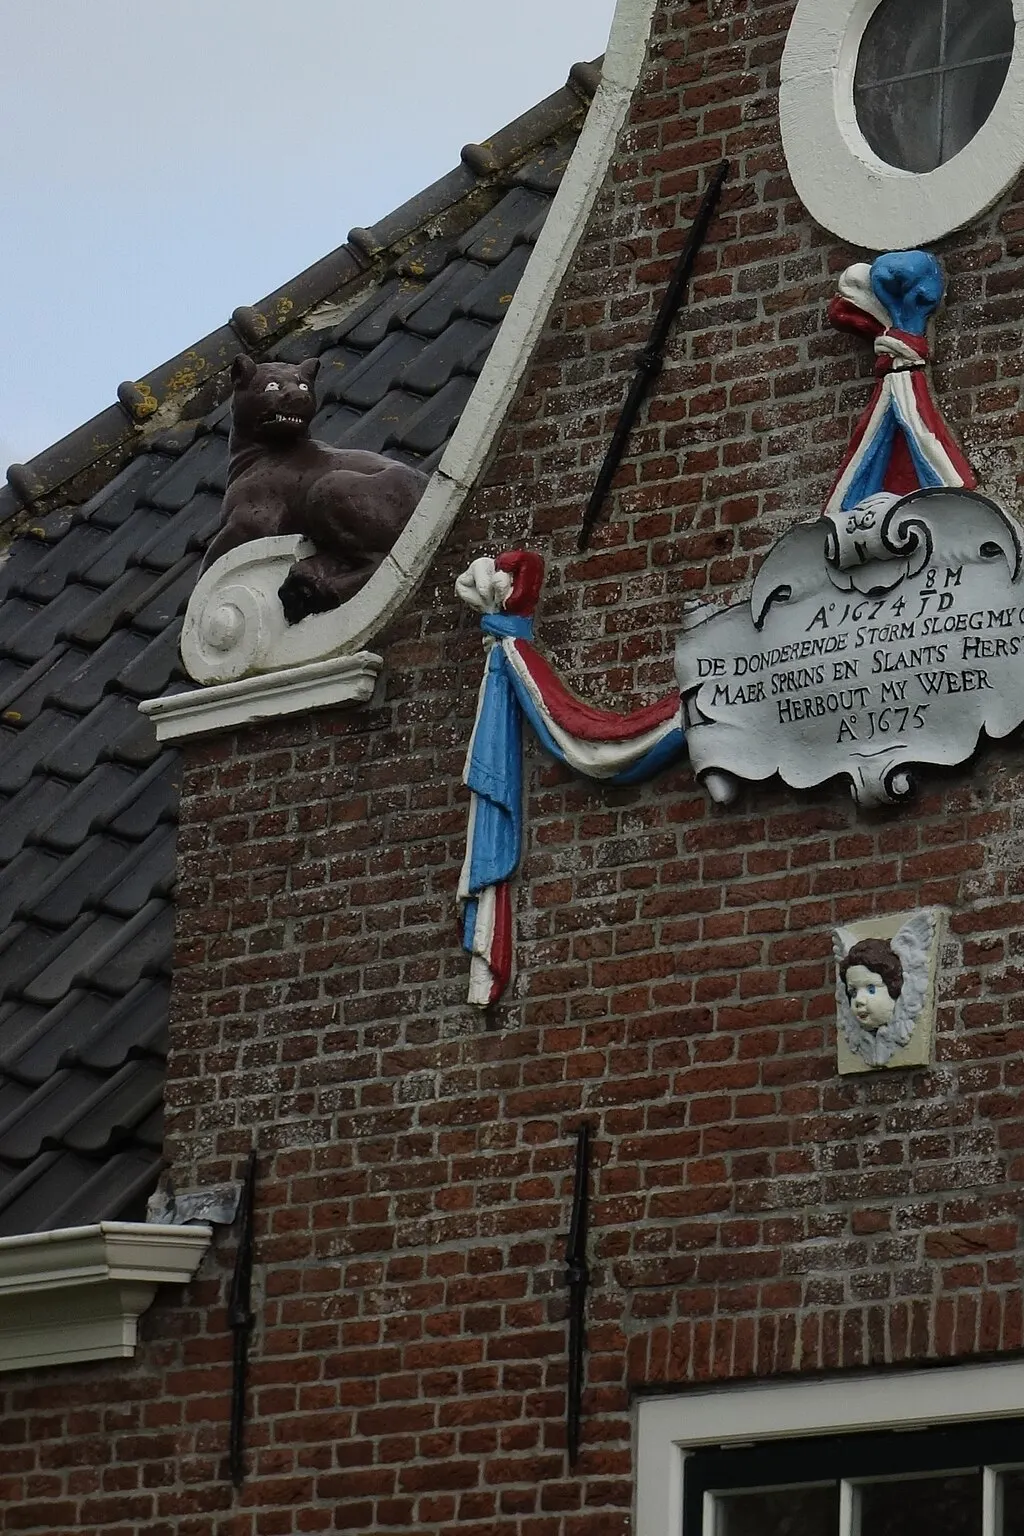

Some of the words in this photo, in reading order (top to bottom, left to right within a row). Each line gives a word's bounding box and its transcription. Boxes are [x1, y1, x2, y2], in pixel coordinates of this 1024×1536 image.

[925, 568, 937, 589] 8
[943, 565, 963, 588] M
[936, 592, 955, 613] D
[697, 657, 727, 678] DE
[732, 632, 849, 677] DONDERENDE
[921, 611, 984, 637] SLOEG
[987, 607, 1017, 628] MY
[710, 681, 768, 706] MAER
[771, 664, 826, 696] SPRINS
[832, 659, 860, 681] EN
[871, 644, 948, 674] SLANTS
[776, 686, 872, 724] HERBOUT
[881, 679, 908, 703] MY
[915, 668, 994, 695] WEER
